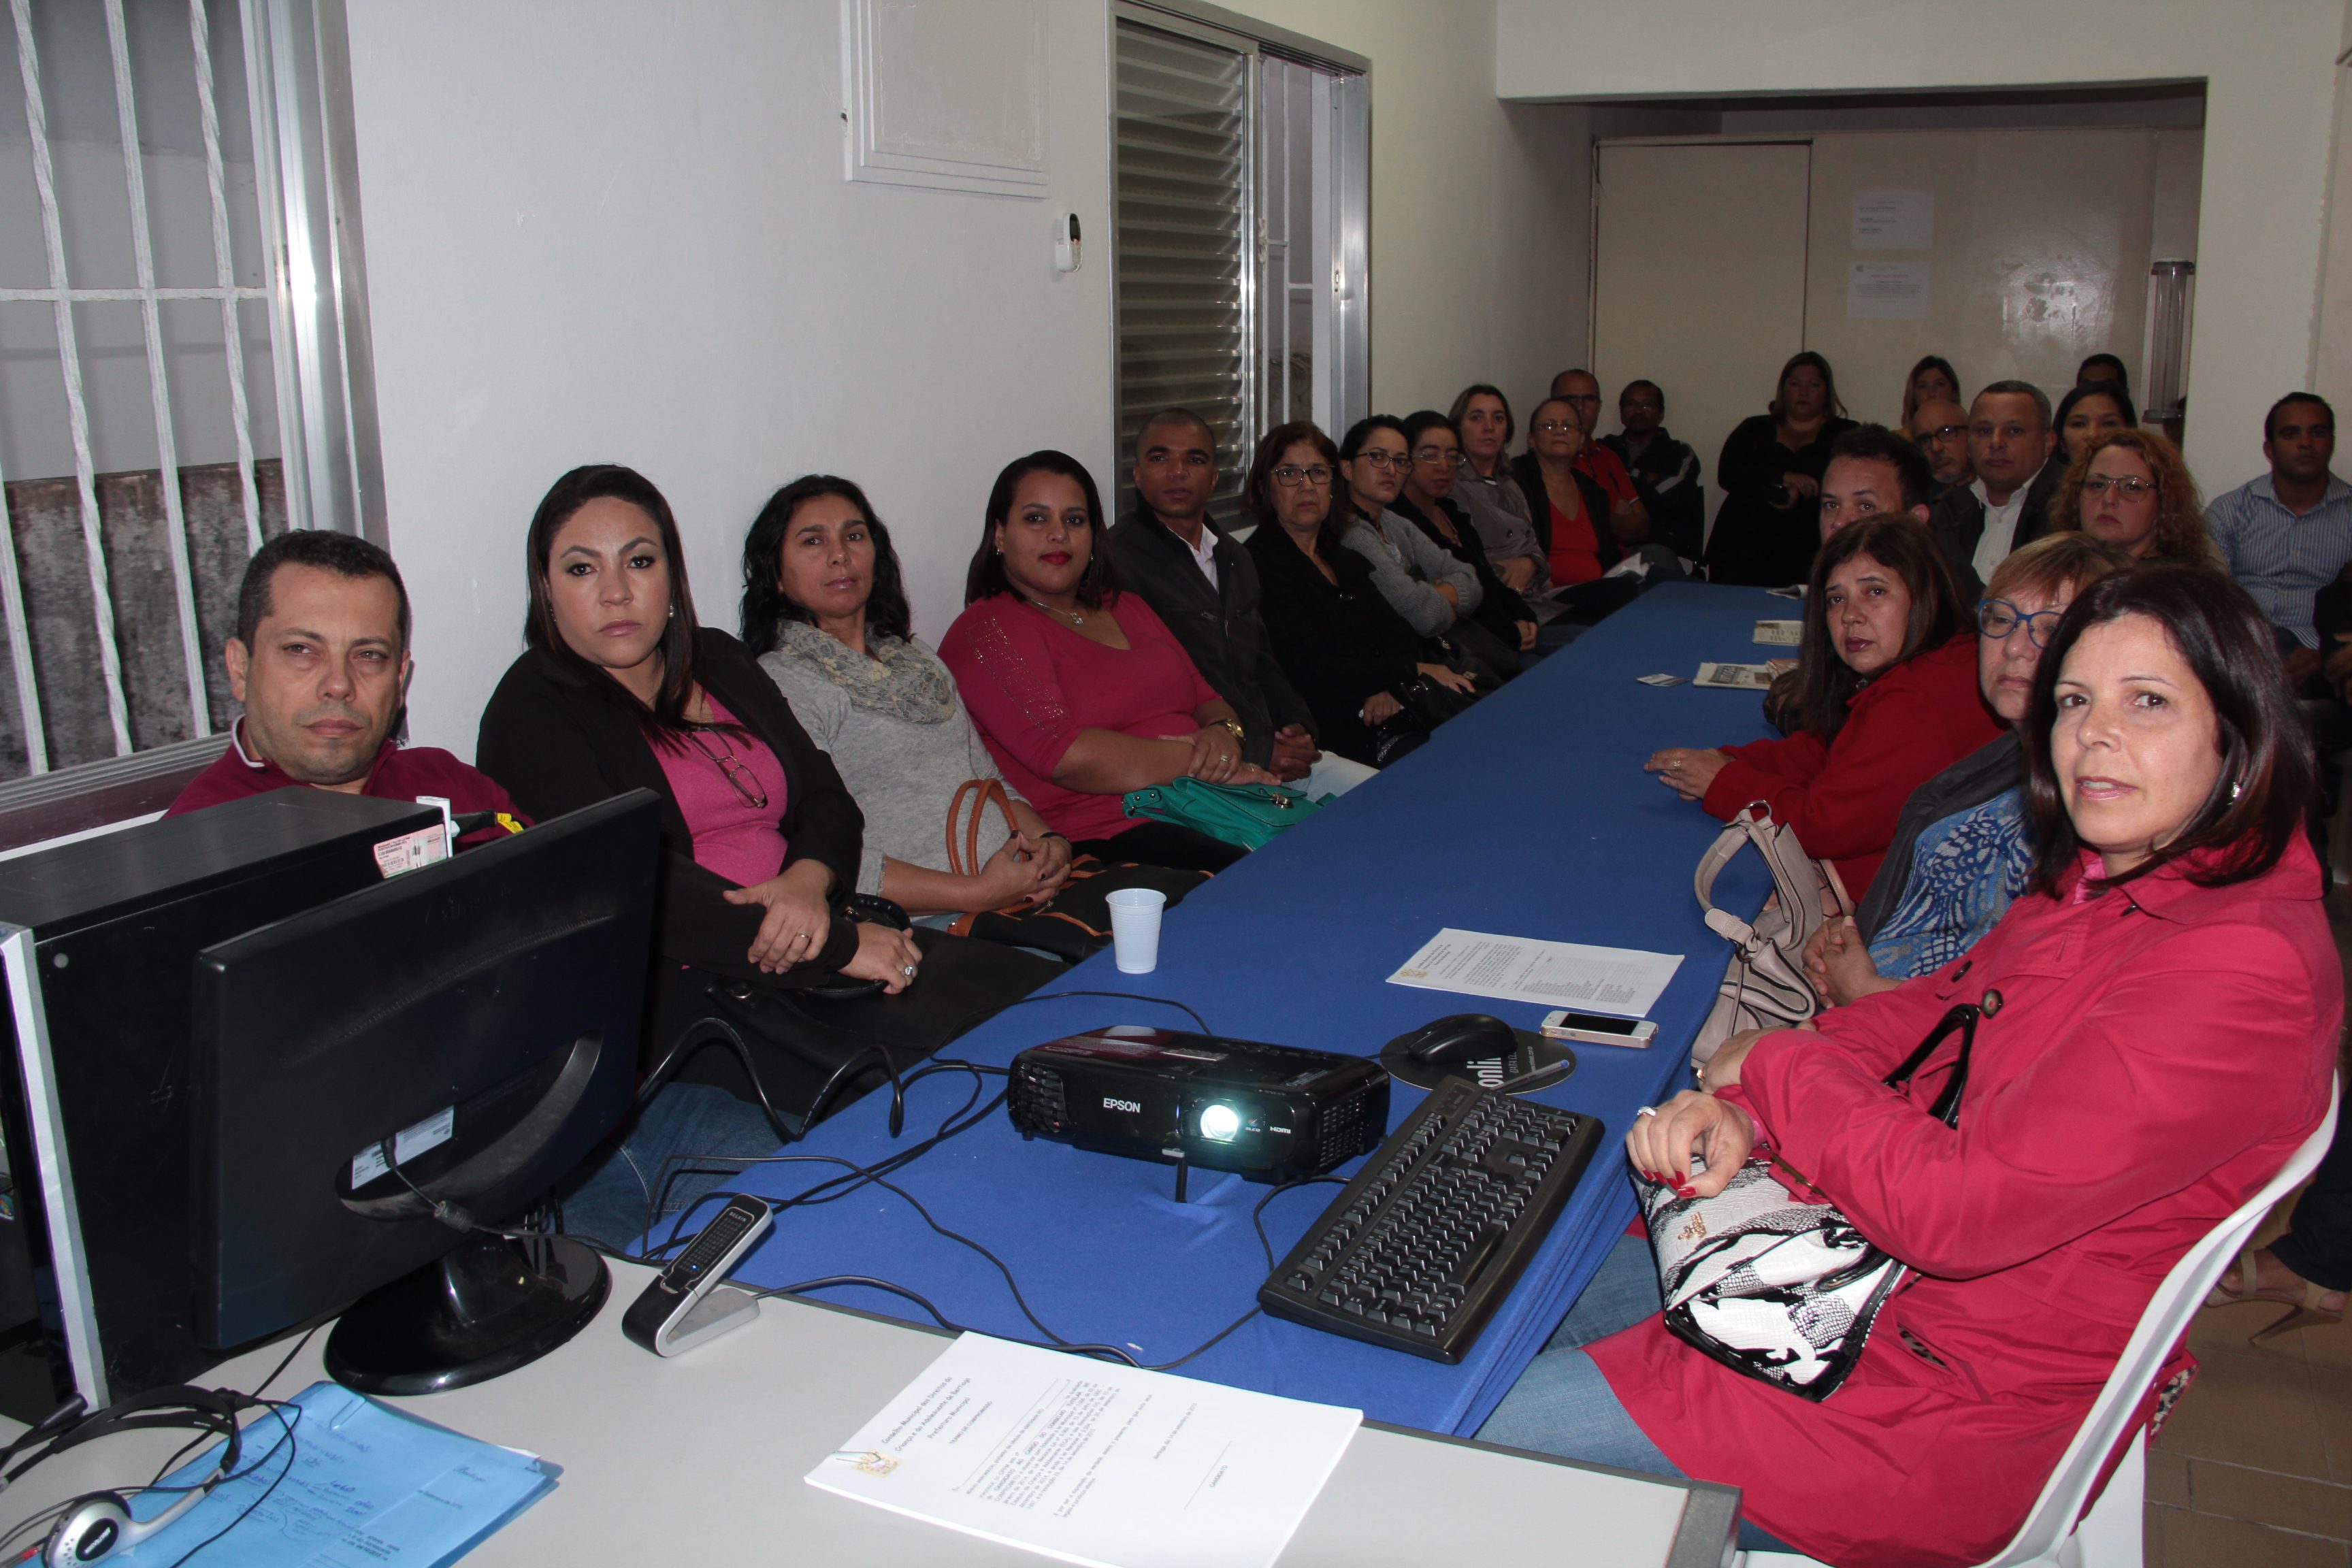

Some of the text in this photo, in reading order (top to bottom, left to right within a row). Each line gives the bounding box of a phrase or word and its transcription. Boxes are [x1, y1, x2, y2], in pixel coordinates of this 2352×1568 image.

[1467, 1057, 1504, 1088] onli
[1102, 1098, 1141, 1113] EPSON
[1270, 1126, 1291, 1134] HDMI
[730, 1211, 747, 1222] BELKIN
[881, 1426, 903, 1443] Conselho
[900, 1406, 922, 1426] Municipal
[927, 1382, 947, 1399] Direitos
[921, 1401, 948, 1426] Adolescente
[927, 1397, 970, 1439] Prefeitura Municipal
[1209, 1465, 1228, 1487] CANDIDATO
